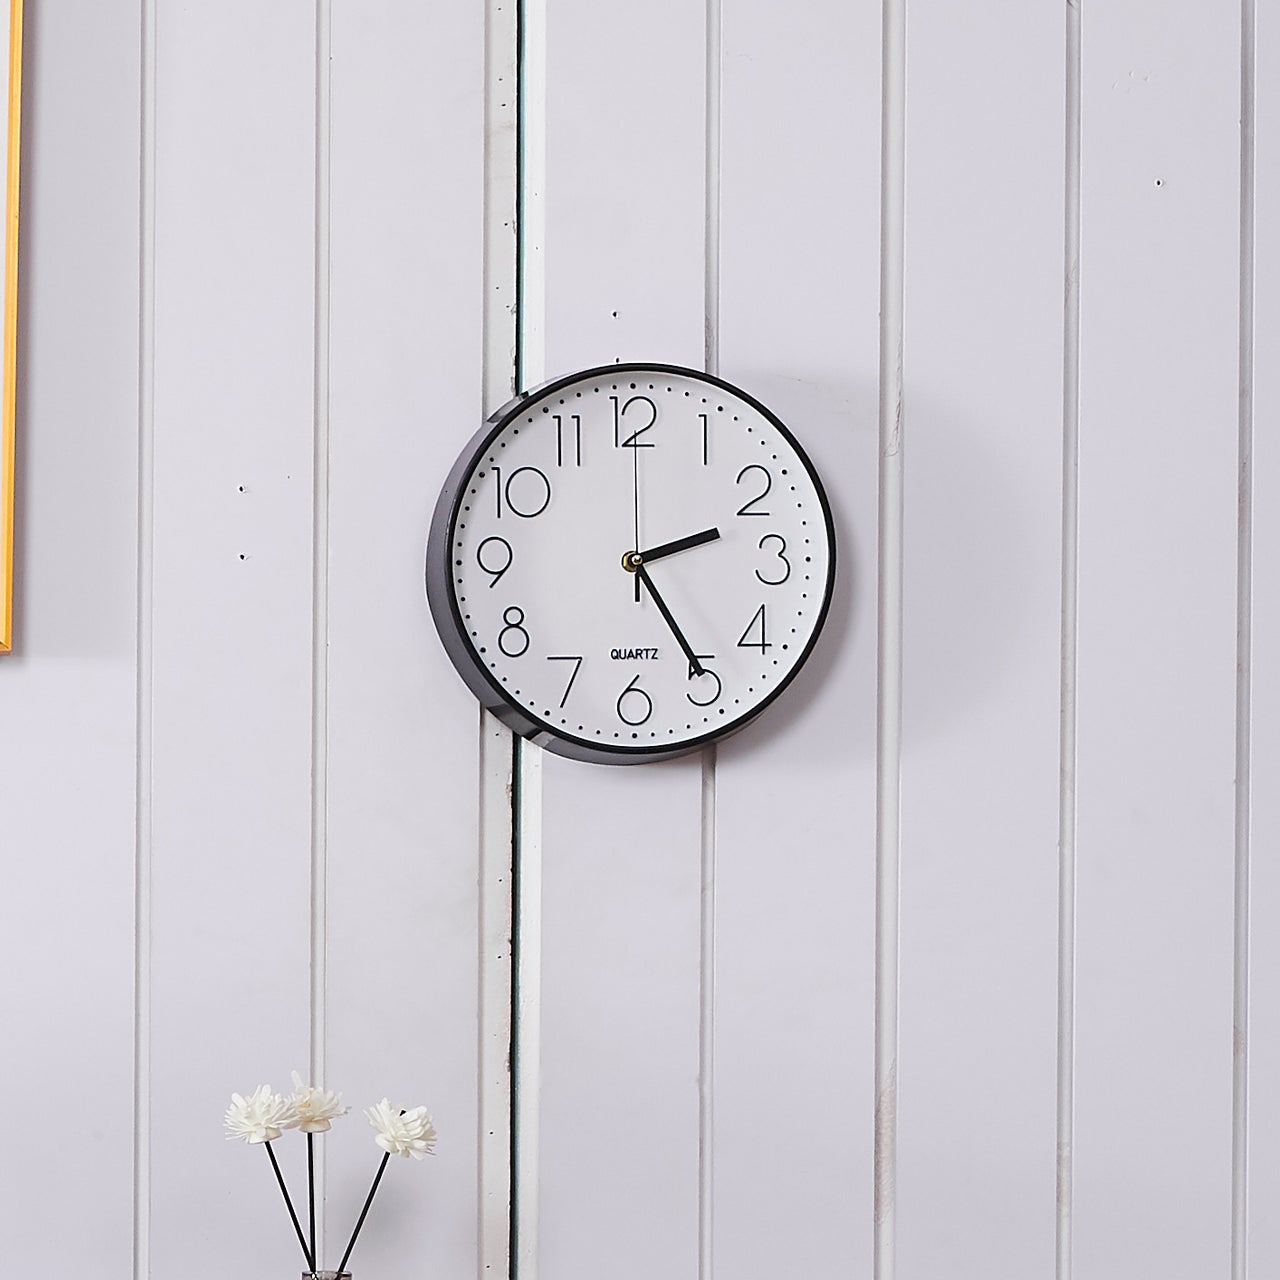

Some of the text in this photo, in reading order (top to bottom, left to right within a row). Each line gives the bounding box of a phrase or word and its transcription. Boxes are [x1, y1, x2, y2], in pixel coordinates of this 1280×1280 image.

[552, 415, 581, 467] 11
[609, 396, 657, 447] 12
[698, 414, 708, 465] 1
[491, 467, 551, 518] 10
[736, 465, 772, 515] 2
[477, 537, 513, 588] 9
[755, 534, 791, 585] 3
[498, 607, 530, 657] 8
[610, 648, 659, 660] QUARTZ
[737, 604, 773, 655] 4
[547, 657, 583, 707] 7
[617, 675, 653, 726] 6
[687, 655, 722, 705] 5
